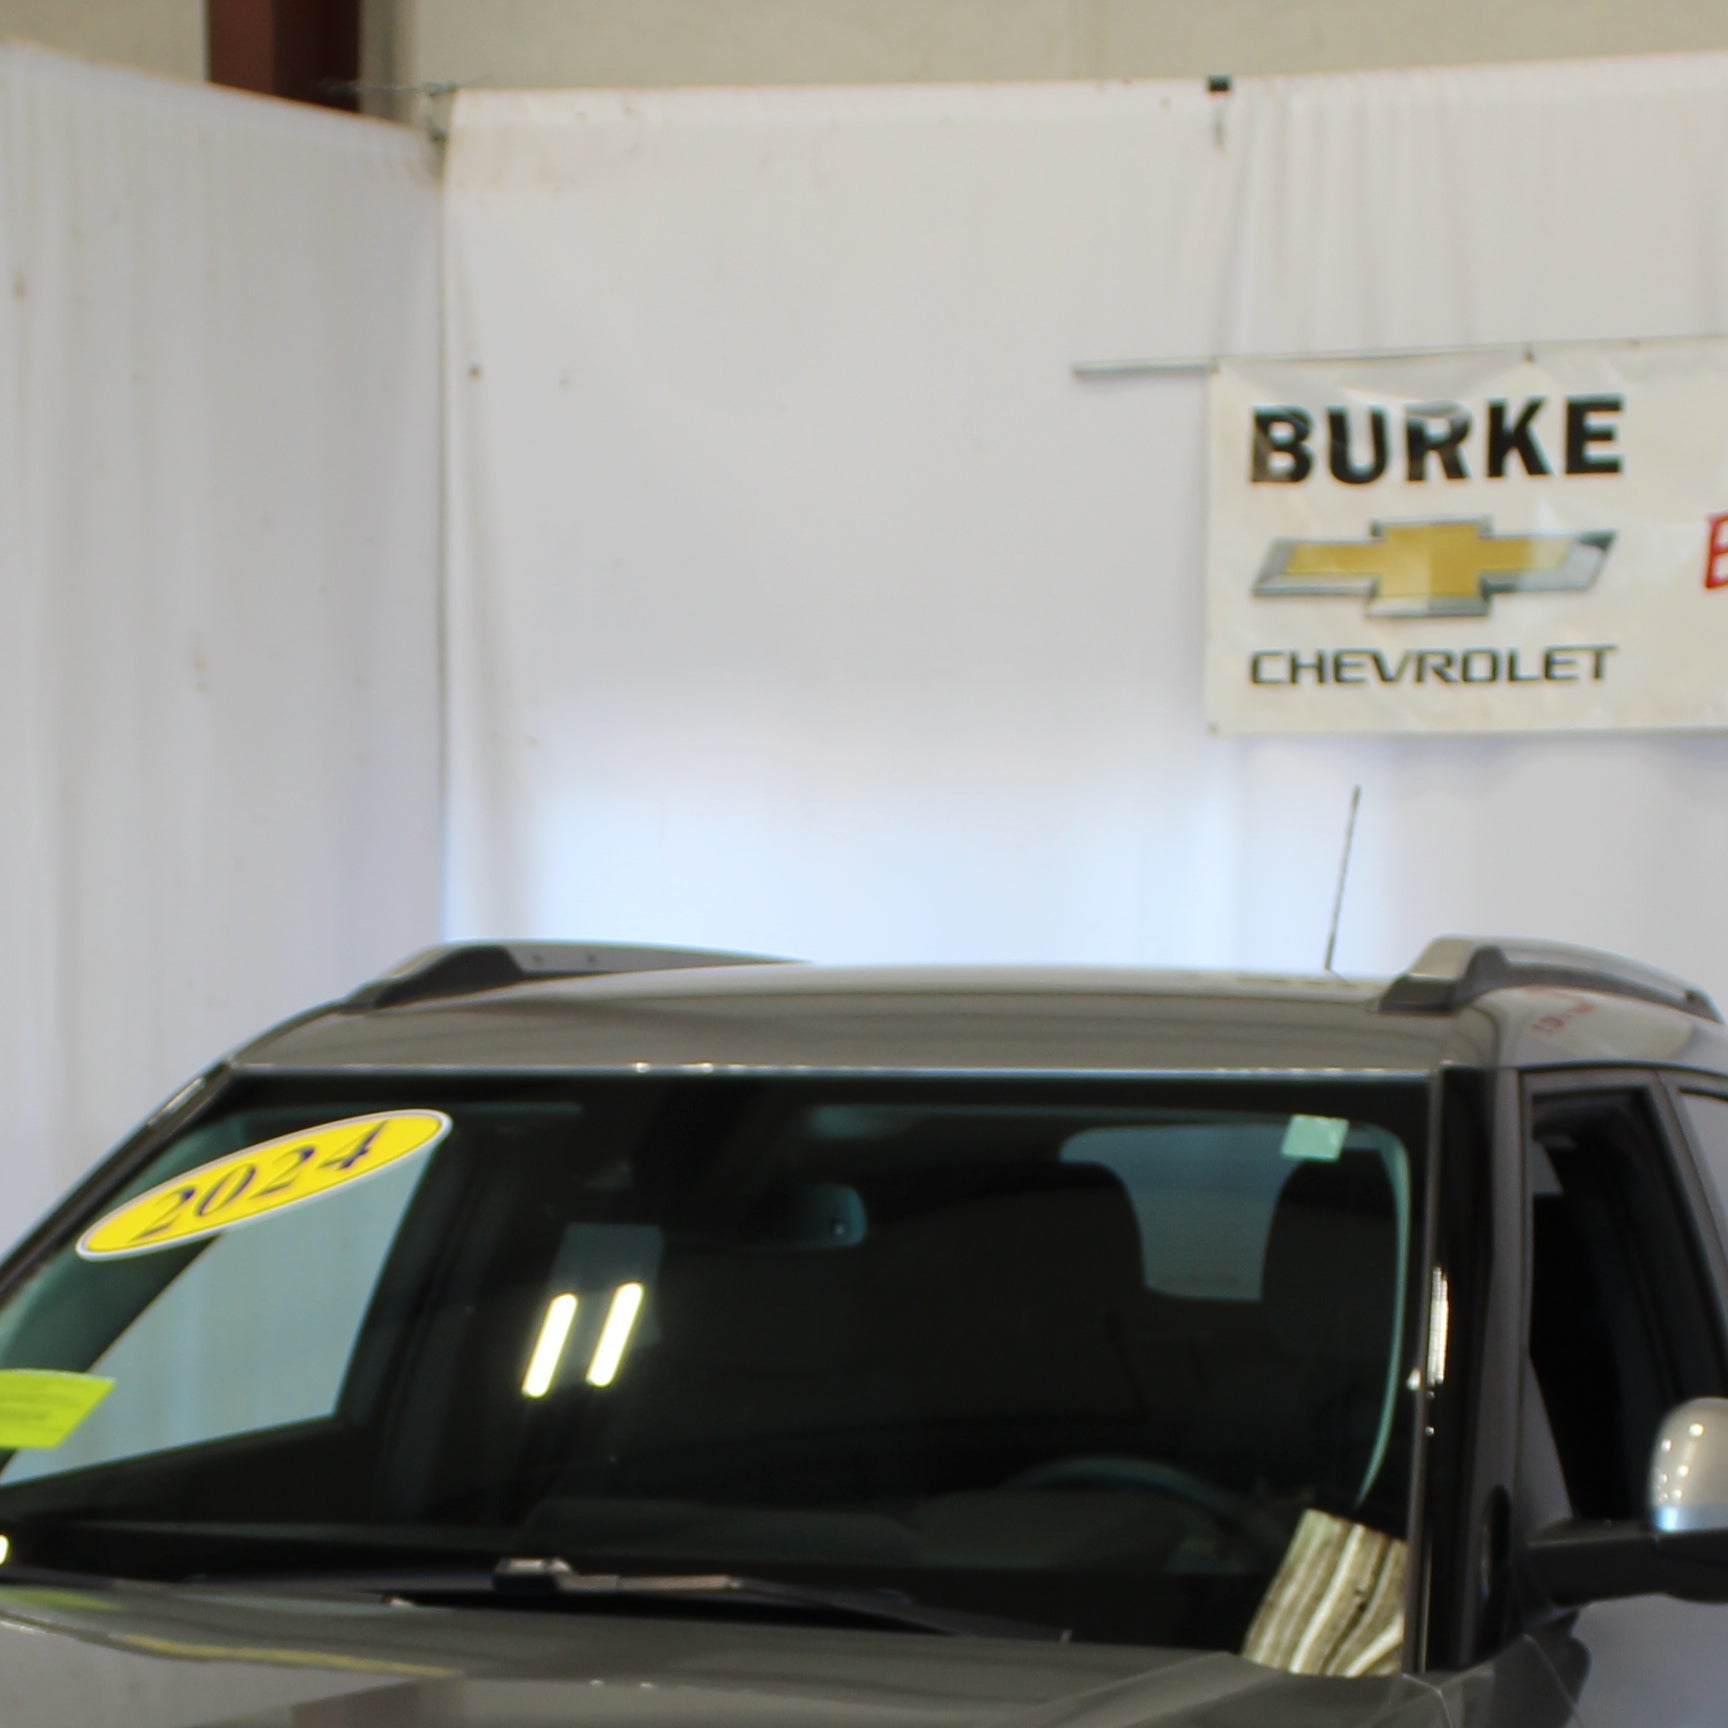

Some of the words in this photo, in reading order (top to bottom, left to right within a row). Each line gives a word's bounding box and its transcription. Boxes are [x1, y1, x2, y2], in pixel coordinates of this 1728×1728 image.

[1249, 396, 1622, 485] BURKE
[1249, 644, 1617, 686] CHEVROLET
[127, 1120, 391, 1242] 2024
